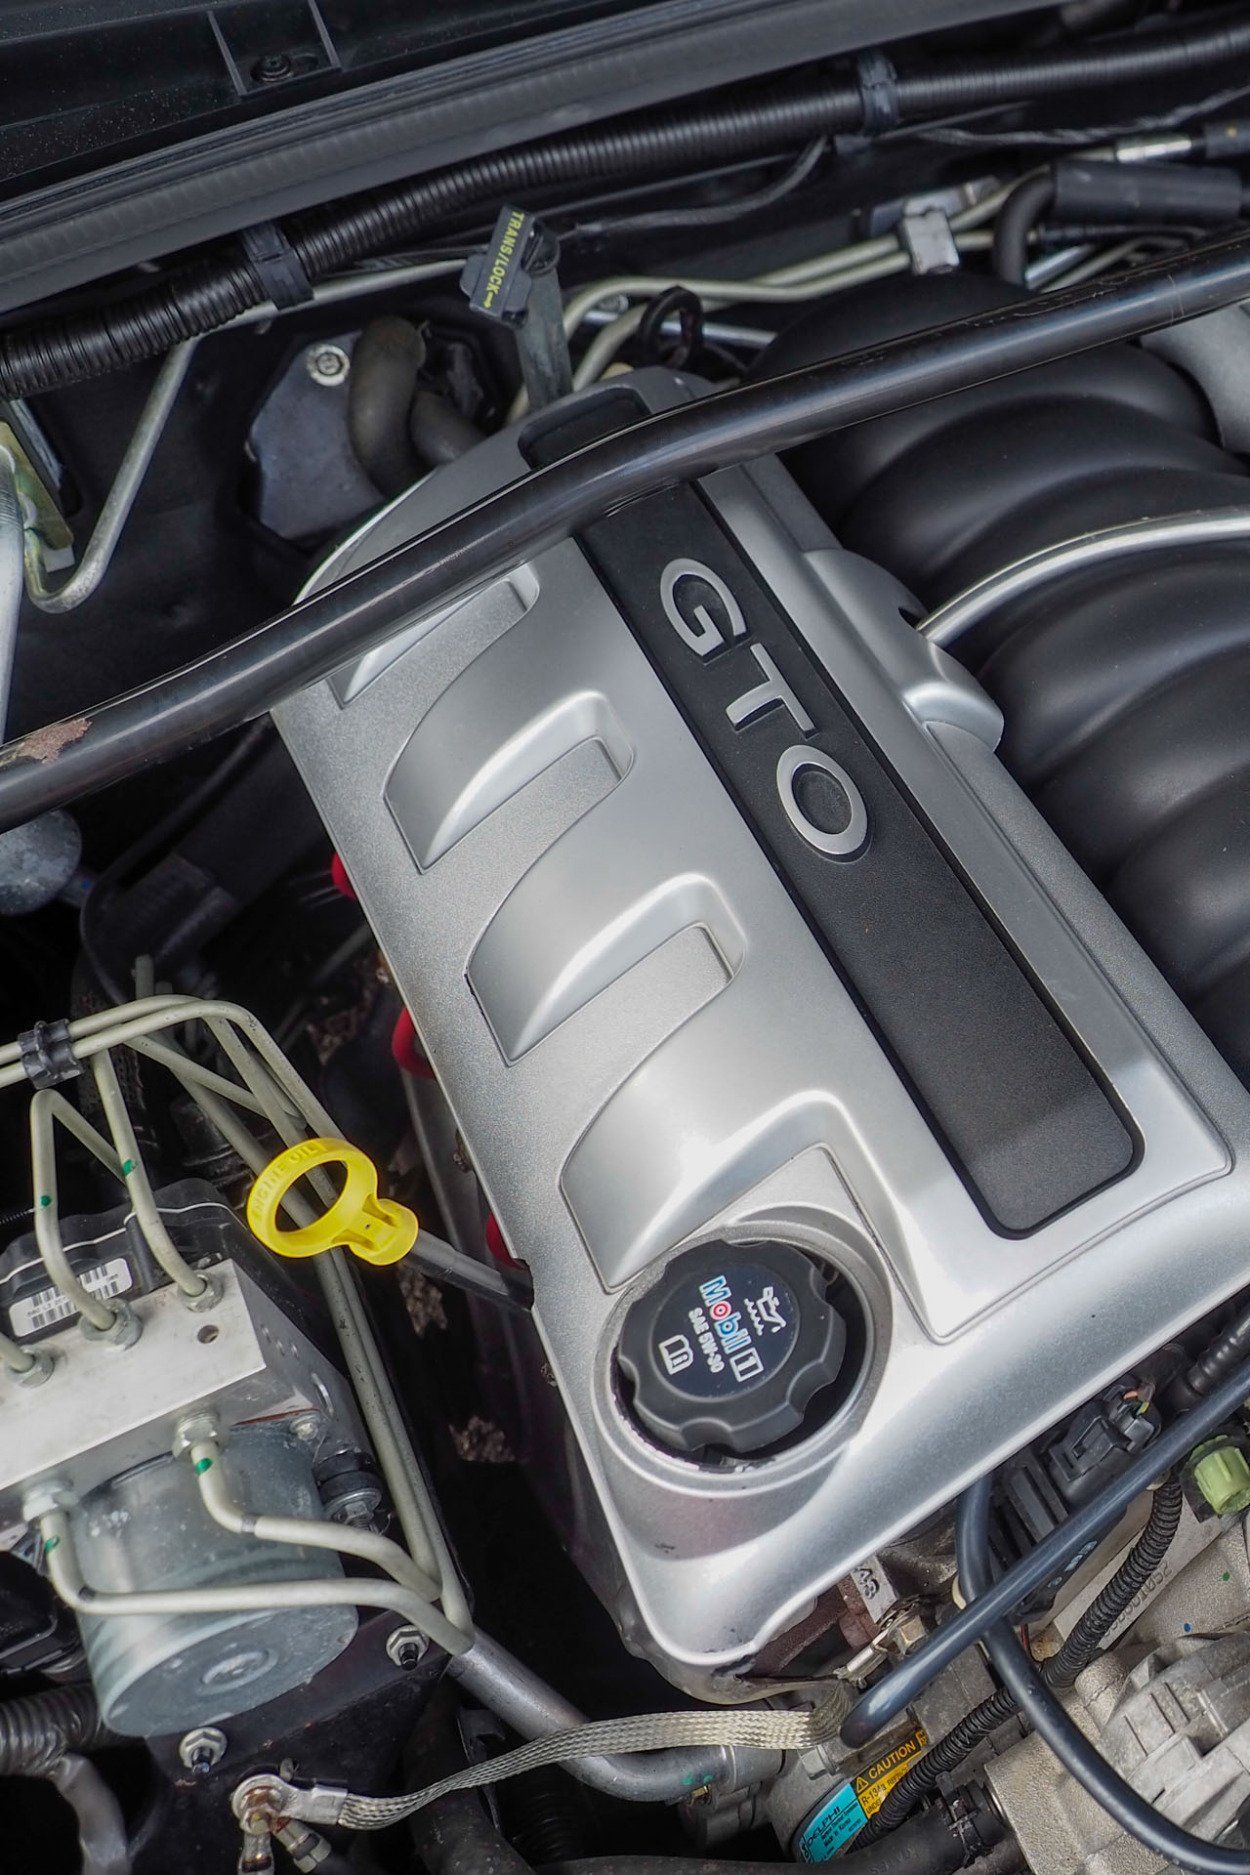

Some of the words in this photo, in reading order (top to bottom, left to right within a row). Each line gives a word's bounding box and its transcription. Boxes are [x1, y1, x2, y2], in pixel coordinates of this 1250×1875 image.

[486, 210, 525, 295] TRANS/LOCK
[660, 557, 869, 856] GTO
[688, 1307, 709, 1335] SAE
[699, 1275, 752, 1355] Mobil
[868, 1740, 917, 1780] CAUTION
[806, 1805, 841, 1846] DELPHI
